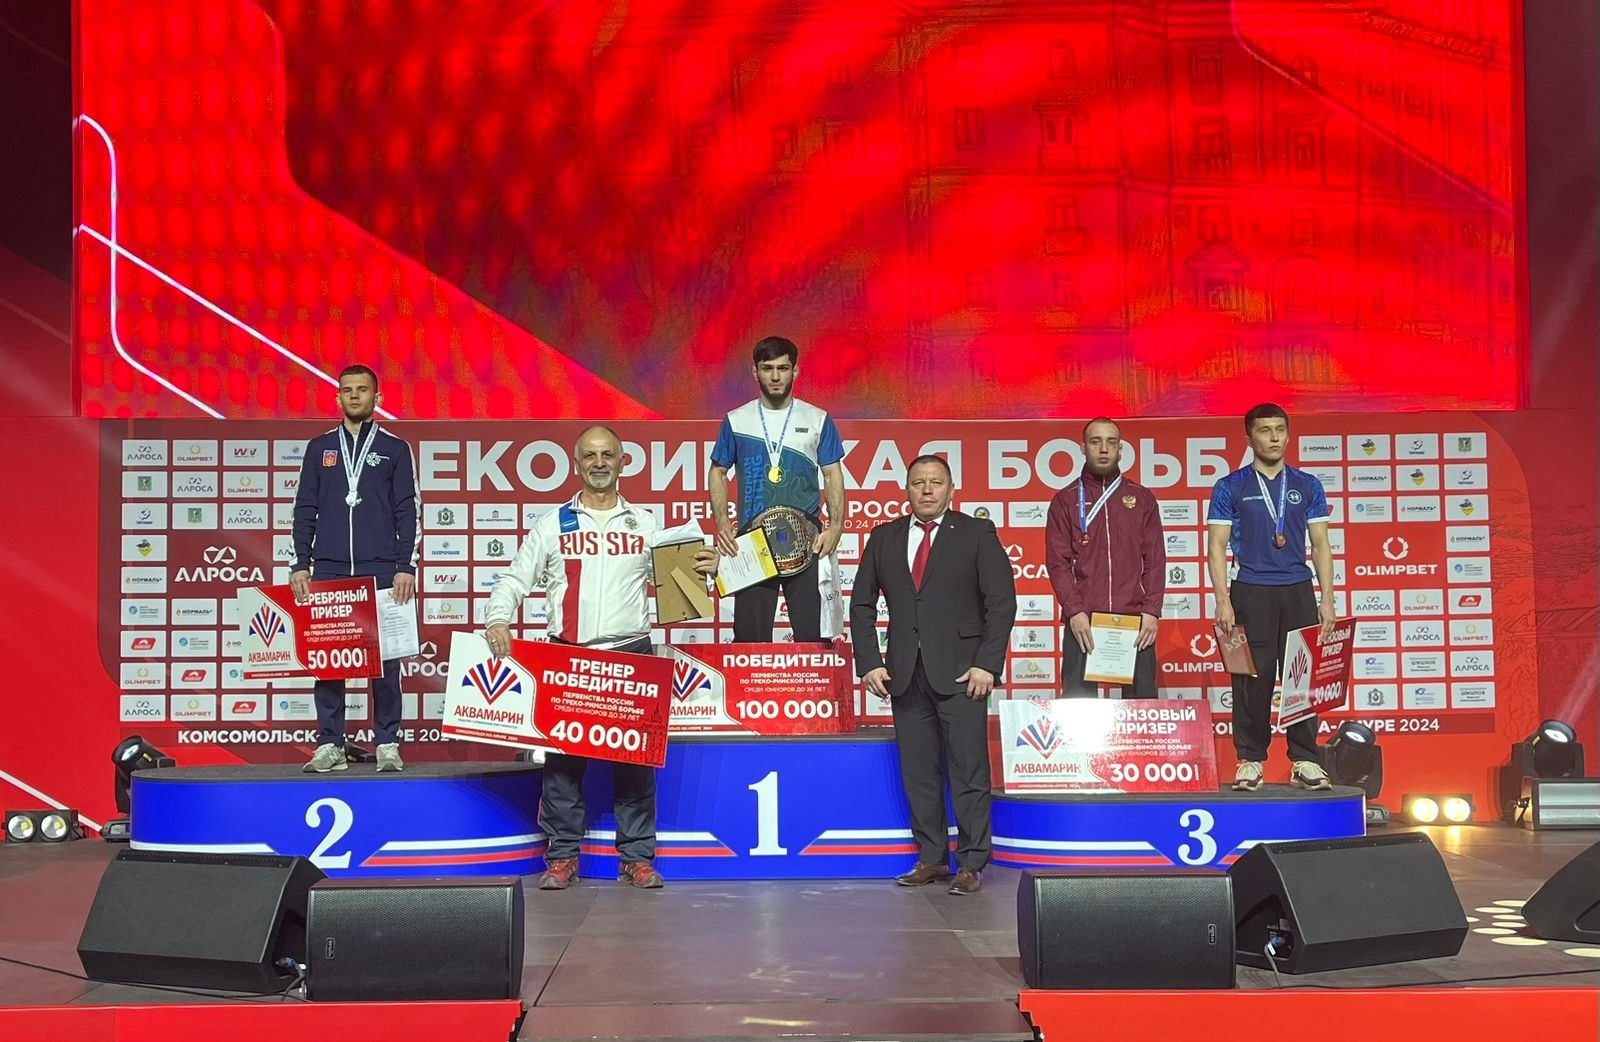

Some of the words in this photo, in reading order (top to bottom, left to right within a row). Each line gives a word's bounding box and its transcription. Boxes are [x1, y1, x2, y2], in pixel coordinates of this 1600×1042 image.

[558, 531, 644, 556] RUSSIA
[174, 567, 265, 582] АЛРОСА
[1355, 565, 1438, 576] OLIMPBET
[311, 605, 353, 620] ПРИЗЕР
[248, 650, 291, 663] АКВАМАРИН
[307, 649, 329, 669] 50
[330, 647, 363, 668] 000
[722, 654, 846, 669] ПОБЕДИТЕЛЬ
[569, 657, 635, 678] ТРЕНЕР
[1162, 663, 1225, 673] OLIMPB
[542, 670, 659, 699] ПОБЕДИТЕЛЯ
[1325, 680, 1341, 703] 000
[550, 696, 561, 704] ПО
[562, 698, 616, 712] ГРЕКО-РИМСКОЙ
[617, 705, 645, 715] БОРЬБЕ
[562, 691, 605, 703] ПЕРВЕНСТВА
[606, 695, 634, 706] РОССИИ
[454, 704, 524, 725] АКВАМАРИН
[554, 704, 574, 713] СРЕДИ
[575, 707, 607, 717] ЮНИОРОВ
[608, 710, 618, 719] ДО
[628, 712, 641, 721] ЛЕТ
[736, 699, 779, 719] 100
[783, 699, 833, 719] 000
[1115, 706, 1197, 721] ОНЗОВЫЙ
[1399, 719, 1439, 732] 2024
[549, 720, 585, 744] 40
[587, 724, 641, 751] 000
[1014, 763, 1081, 774] АКВАМАРИН
[1109, 763, 1140, 783] 30
[1144, 762, 1194, 782] 000
[748, 771, 787, 856] 1
[305, 797, 354, 869] 2
[1178, 808, 1217, 866] 3
